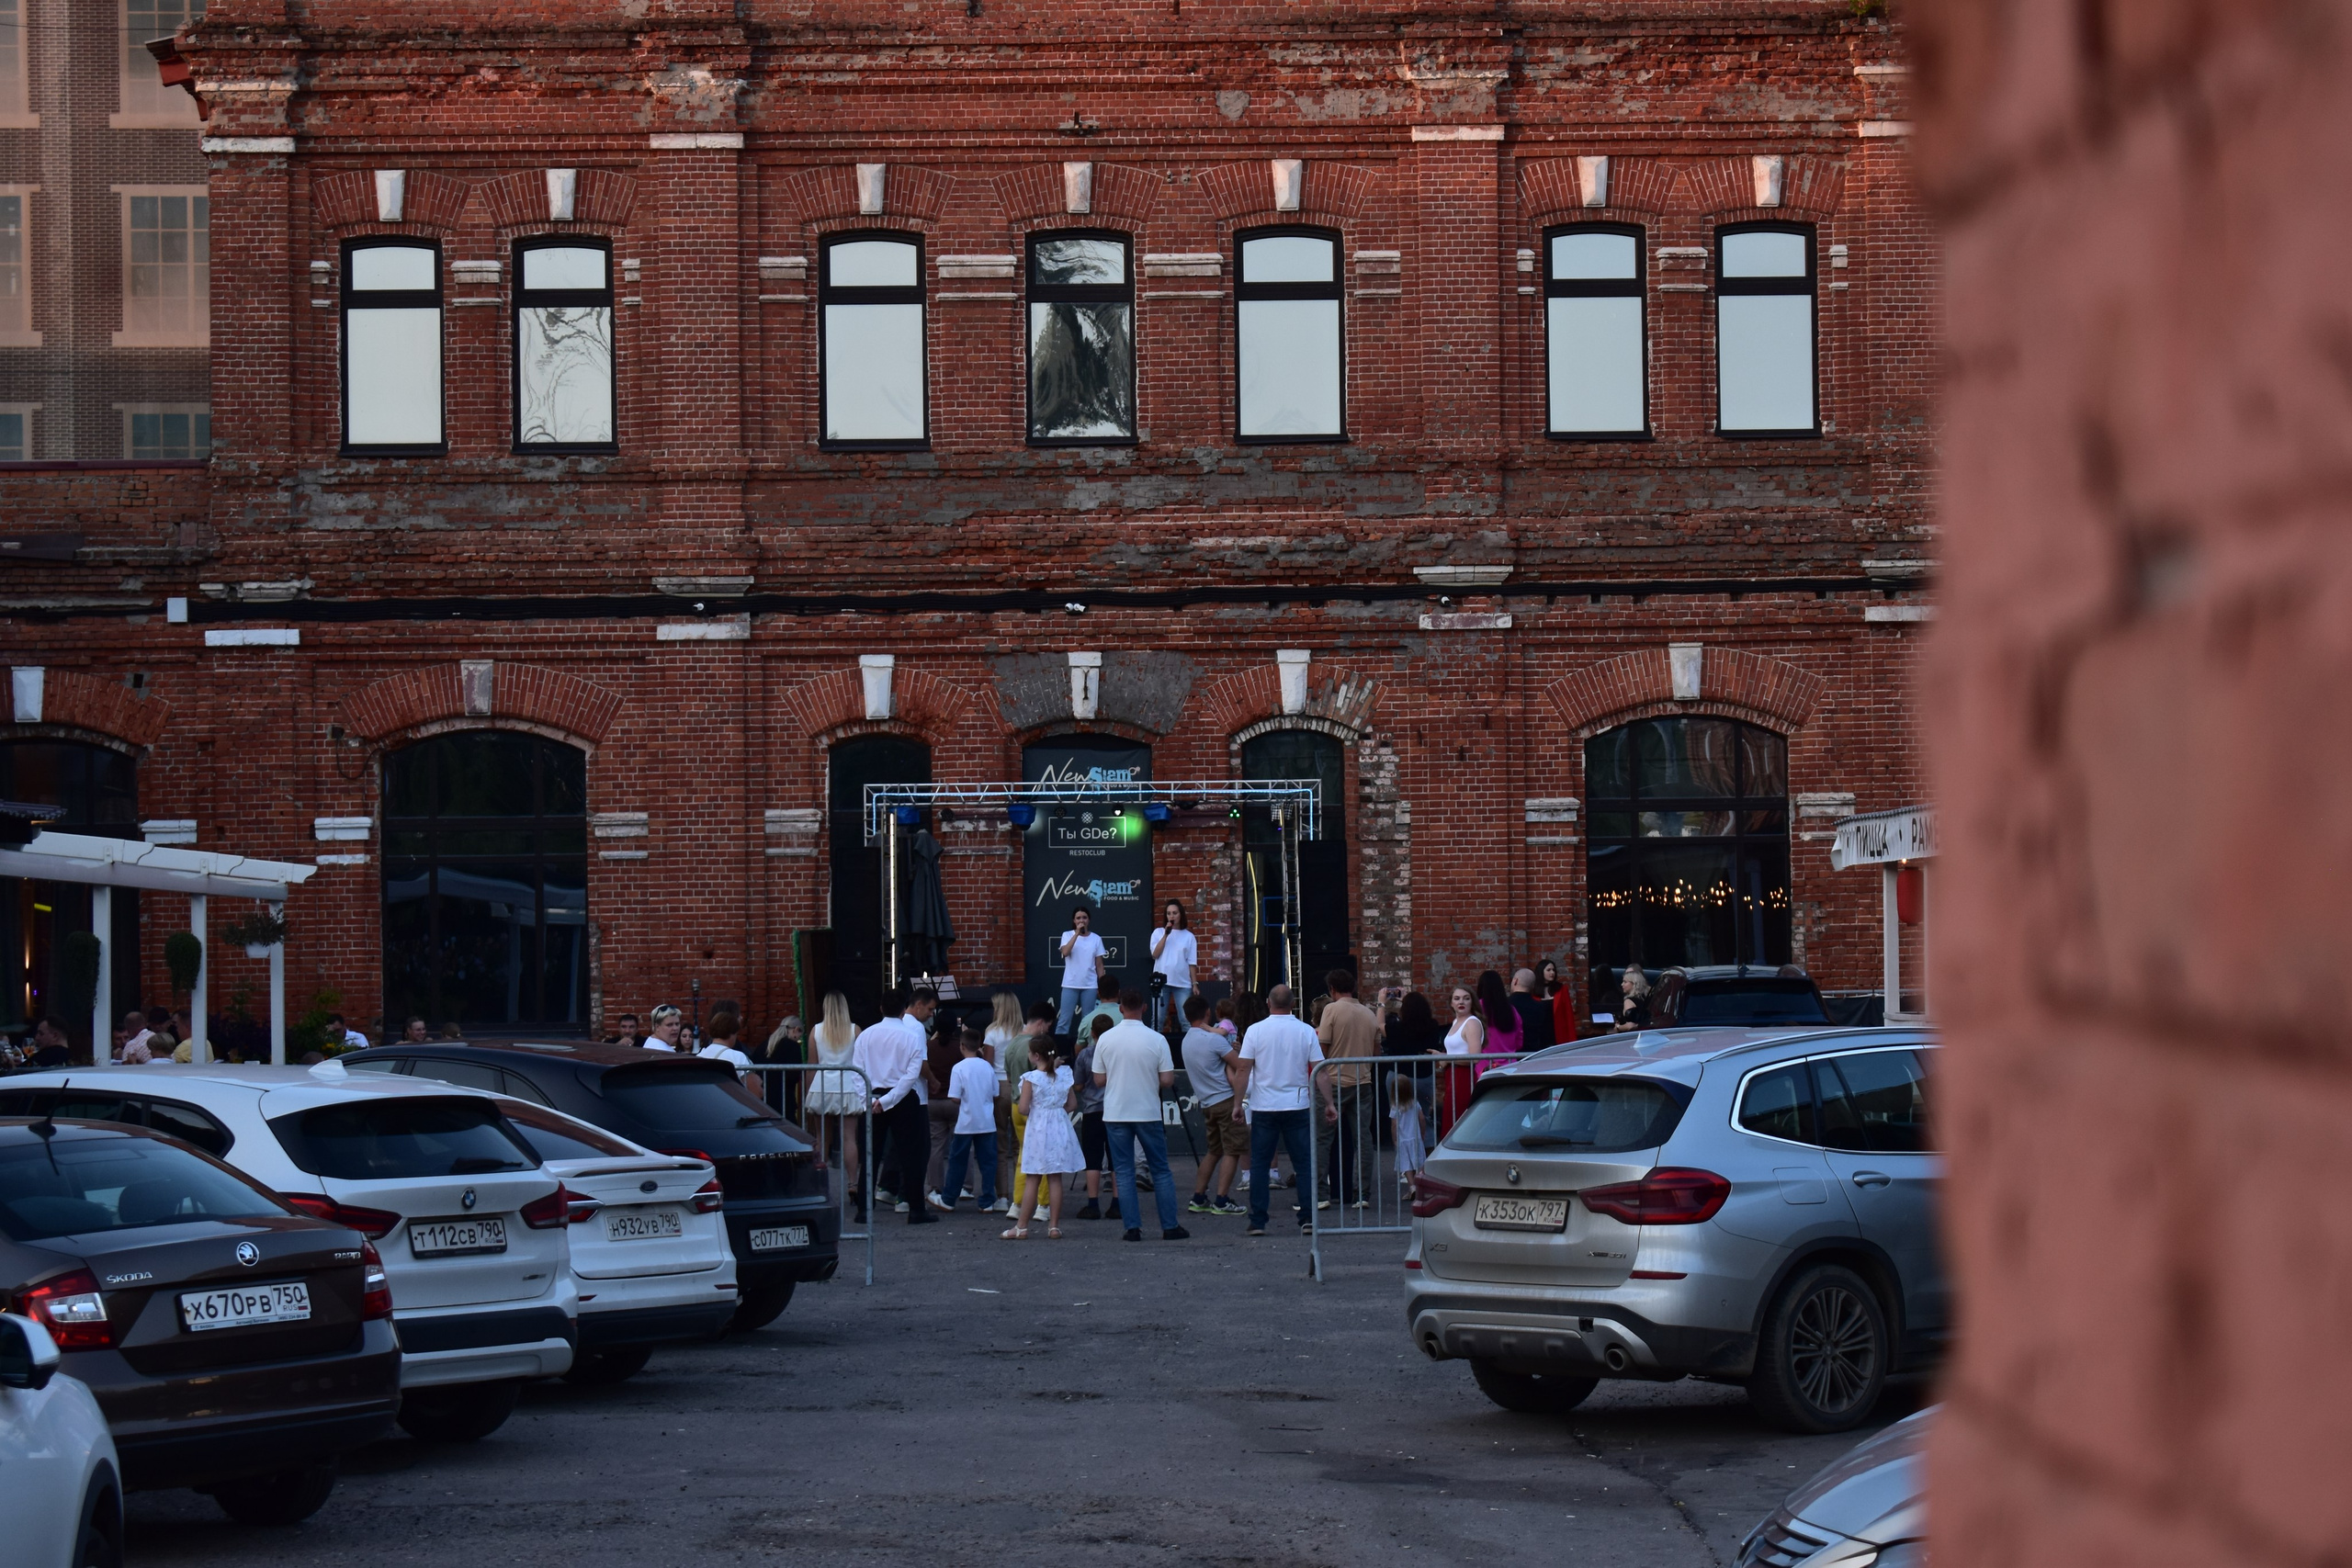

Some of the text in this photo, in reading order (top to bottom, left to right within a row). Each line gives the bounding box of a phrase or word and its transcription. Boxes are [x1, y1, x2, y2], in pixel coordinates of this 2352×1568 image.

[1057, 827, 1117, 840] Ты GDe?
[1856, 822, 1889, 860] ПИЦЦА
[1035, 869, 1091, 907] New
[1539, 1201, 1562, 1217] 797
[659, 1213, 678, 1229] 790
[477, 1222, 500, 1238] 790
[791, 1226, 805, 1240] 777
[190, 1286, 303, 1321] Х670РВ 750
